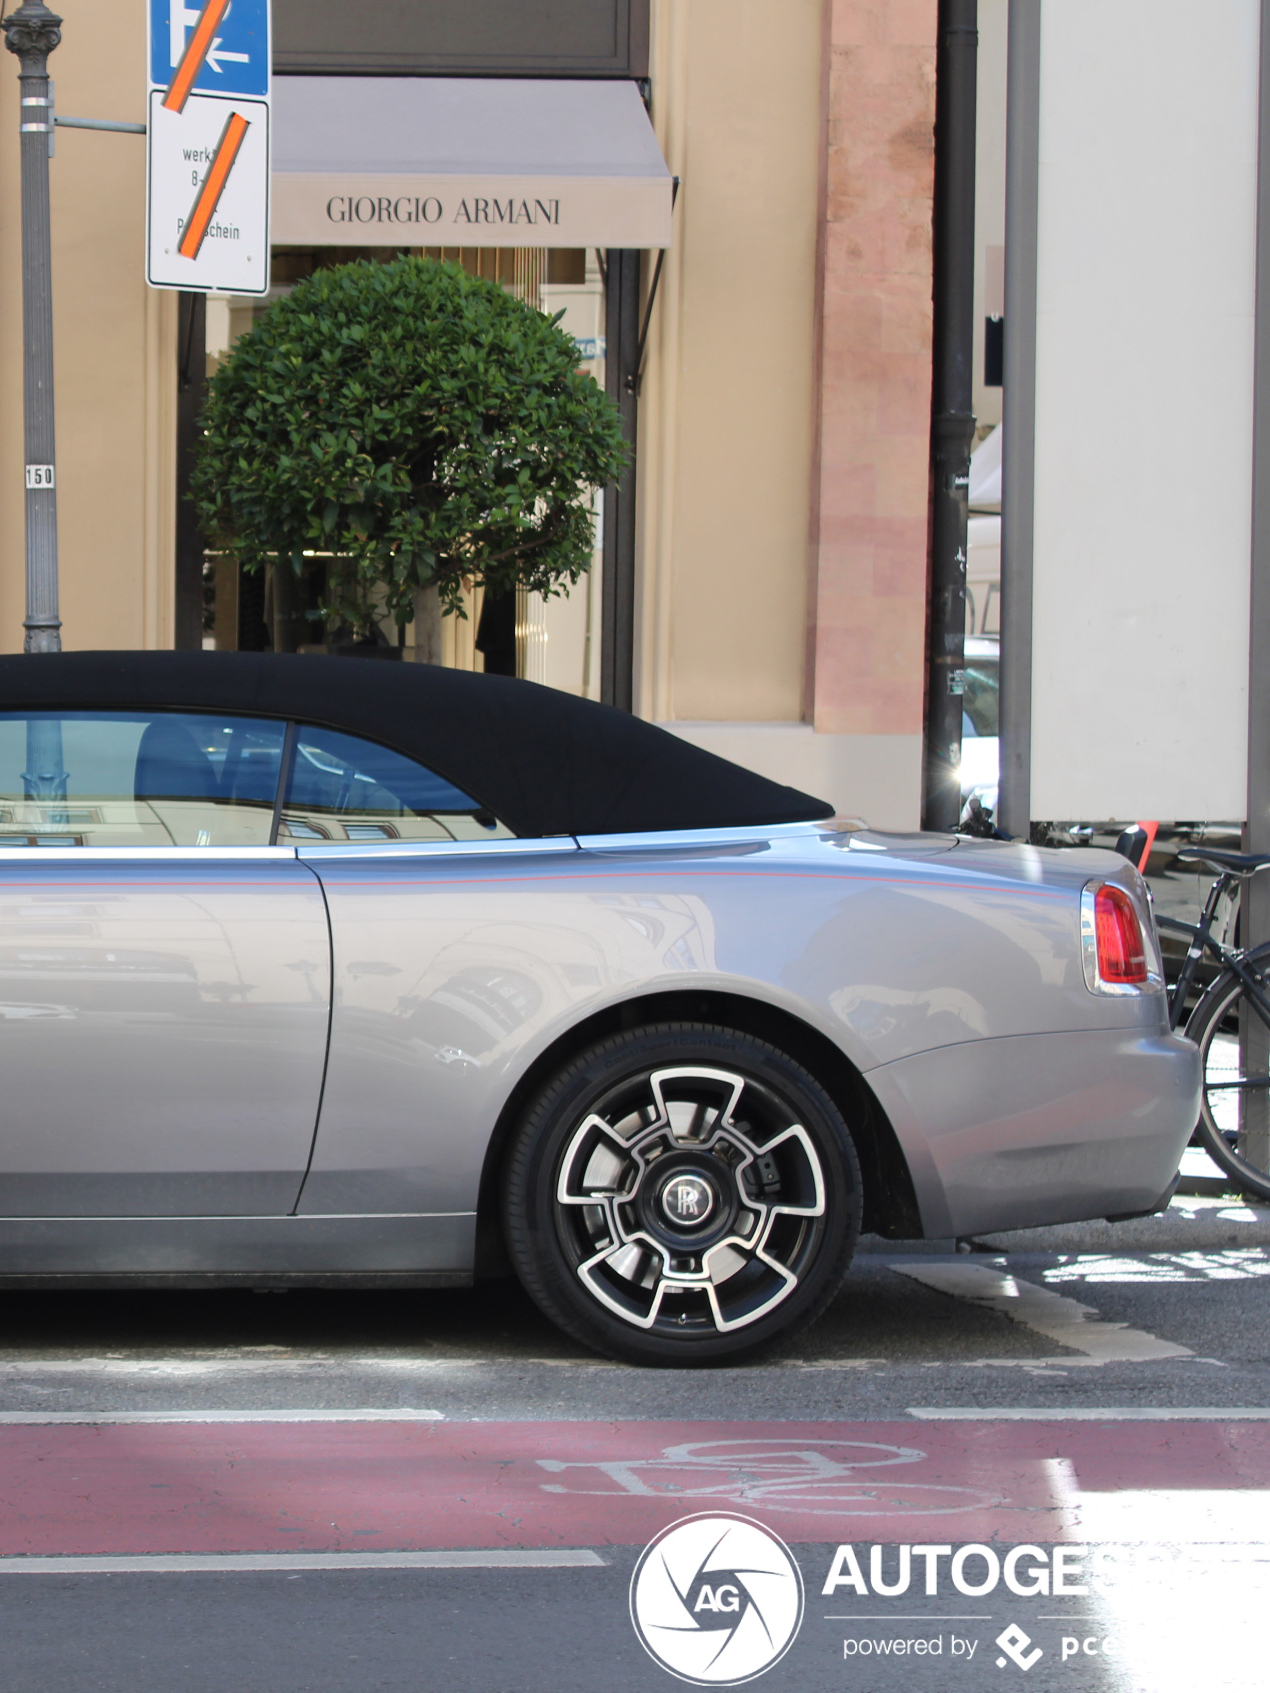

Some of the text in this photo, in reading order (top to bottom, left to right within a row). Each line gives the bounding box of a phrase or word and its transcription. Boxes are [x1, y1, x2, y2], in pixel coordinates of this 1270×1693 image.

[326, 197, 560, 225] GIORGIO ARMANI
[177, 218, 240, 239] Pschein
[26, 468, 52, 485] 150
